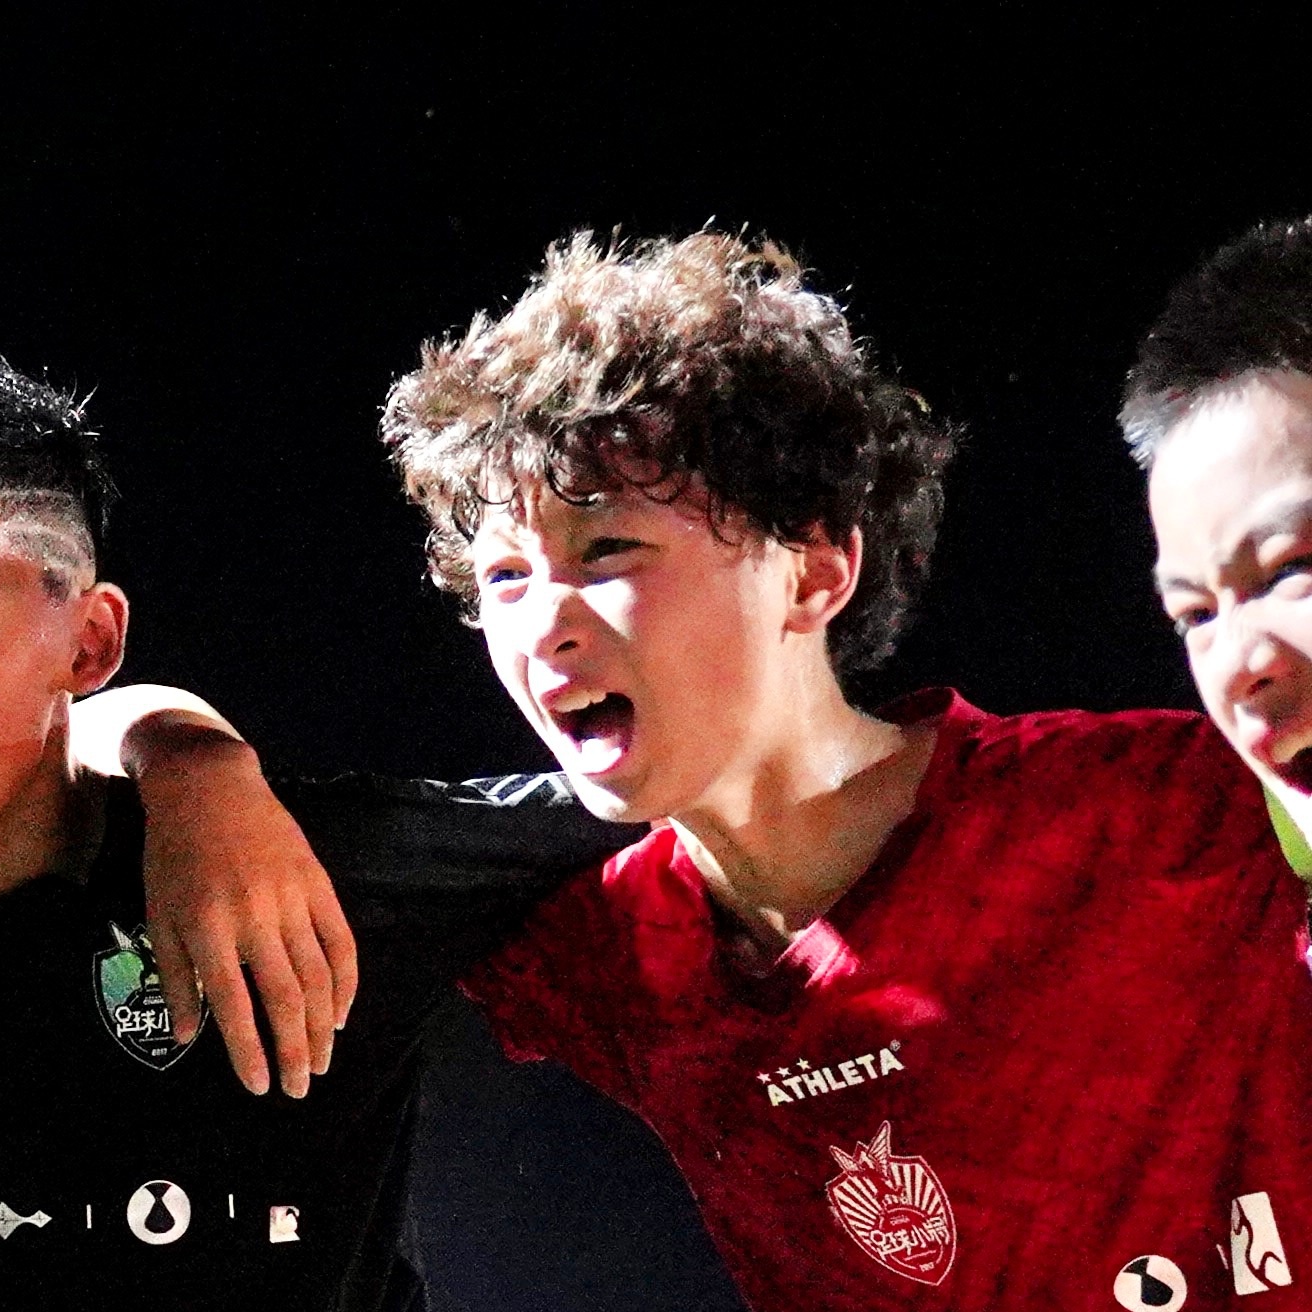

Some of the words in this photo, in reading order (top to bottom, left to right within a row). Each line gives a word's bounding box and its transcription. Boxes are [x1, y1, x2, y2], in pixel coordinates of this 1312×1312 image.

[115, 1006, 171, 1038] 足球小
[767, 1048, 905, 1106] ATHLETA
